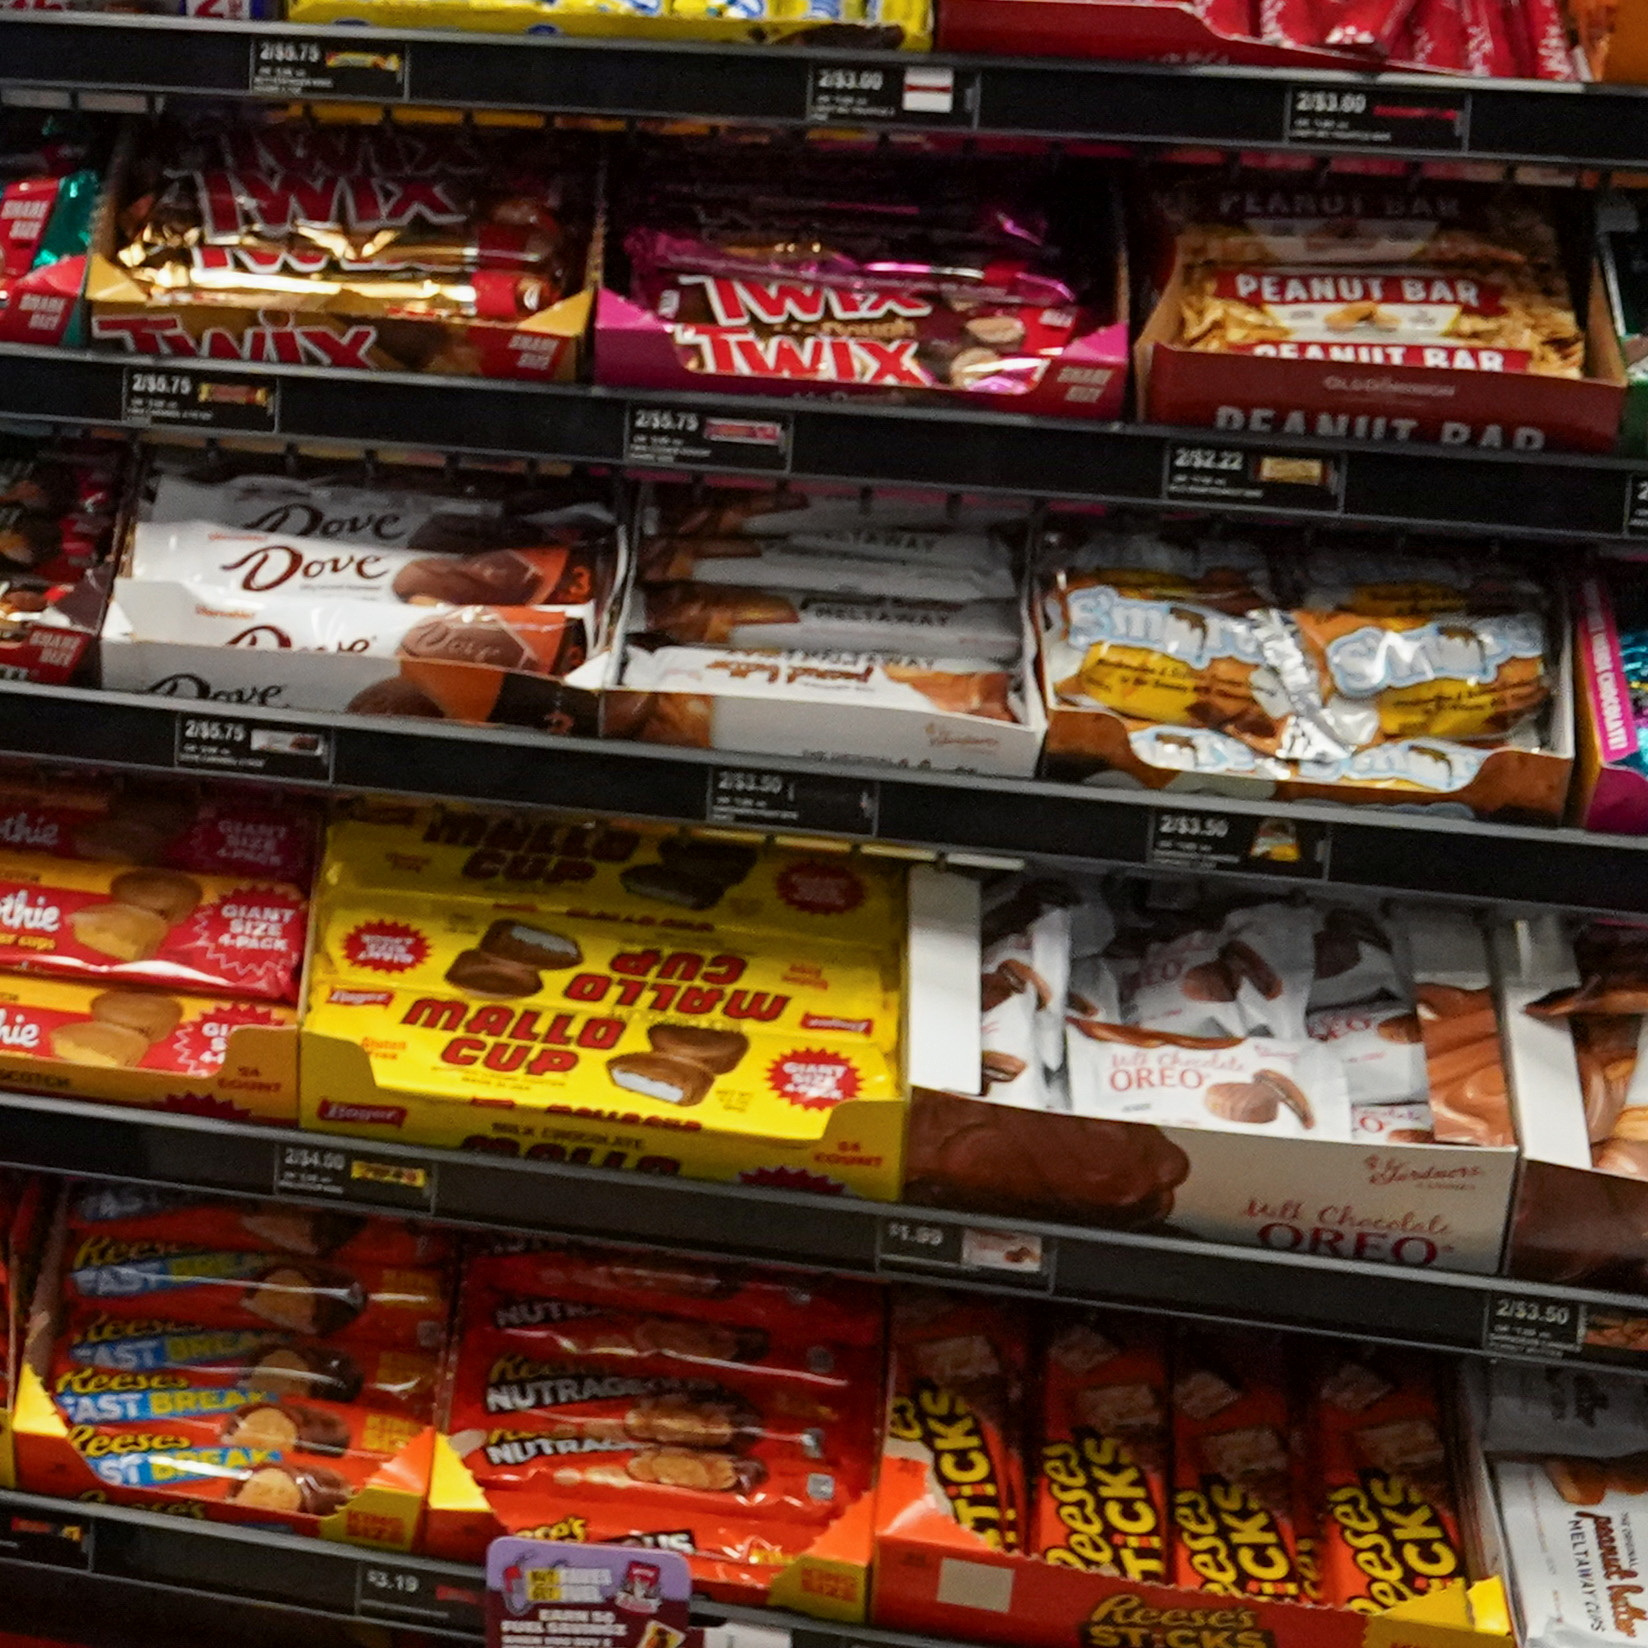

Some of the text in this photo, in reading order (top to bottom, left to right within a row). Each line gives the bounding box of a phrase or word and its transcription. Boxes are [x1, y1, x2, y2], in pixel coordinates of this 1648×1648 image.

[1234, 272, 1480, 307] PEANUT BAR
[238, 502, 403, 542] Dove
[220, 544, 388, 592] Dove
[223, 906, 293, 925] GIANT
[229, 921, 283, 939] SIZE
[18, 934, 56, 951] cups
[218, 933, 289, 952] 4-PACK
[606, 947, 747, 985] CUP
[563, 971, 793, 1024] MALLO
[400, 997, 627, 1051] MALLO
[440, 1036, 580, 1076] CUP
[1109, 1066, 1205, 1094] OREO
[1244, 1198, 1455, 1240] Milk Chocolate
[1258, 1219, 1440, 1269] OREO
[1495, 1300, 1570, 1327] 2/$3.50
[1575, 1510, 1638, 1581] peanut
[366, 1569, 420, 1591] $3.19
[1093, 1594, 1259, 1630] Reese's
